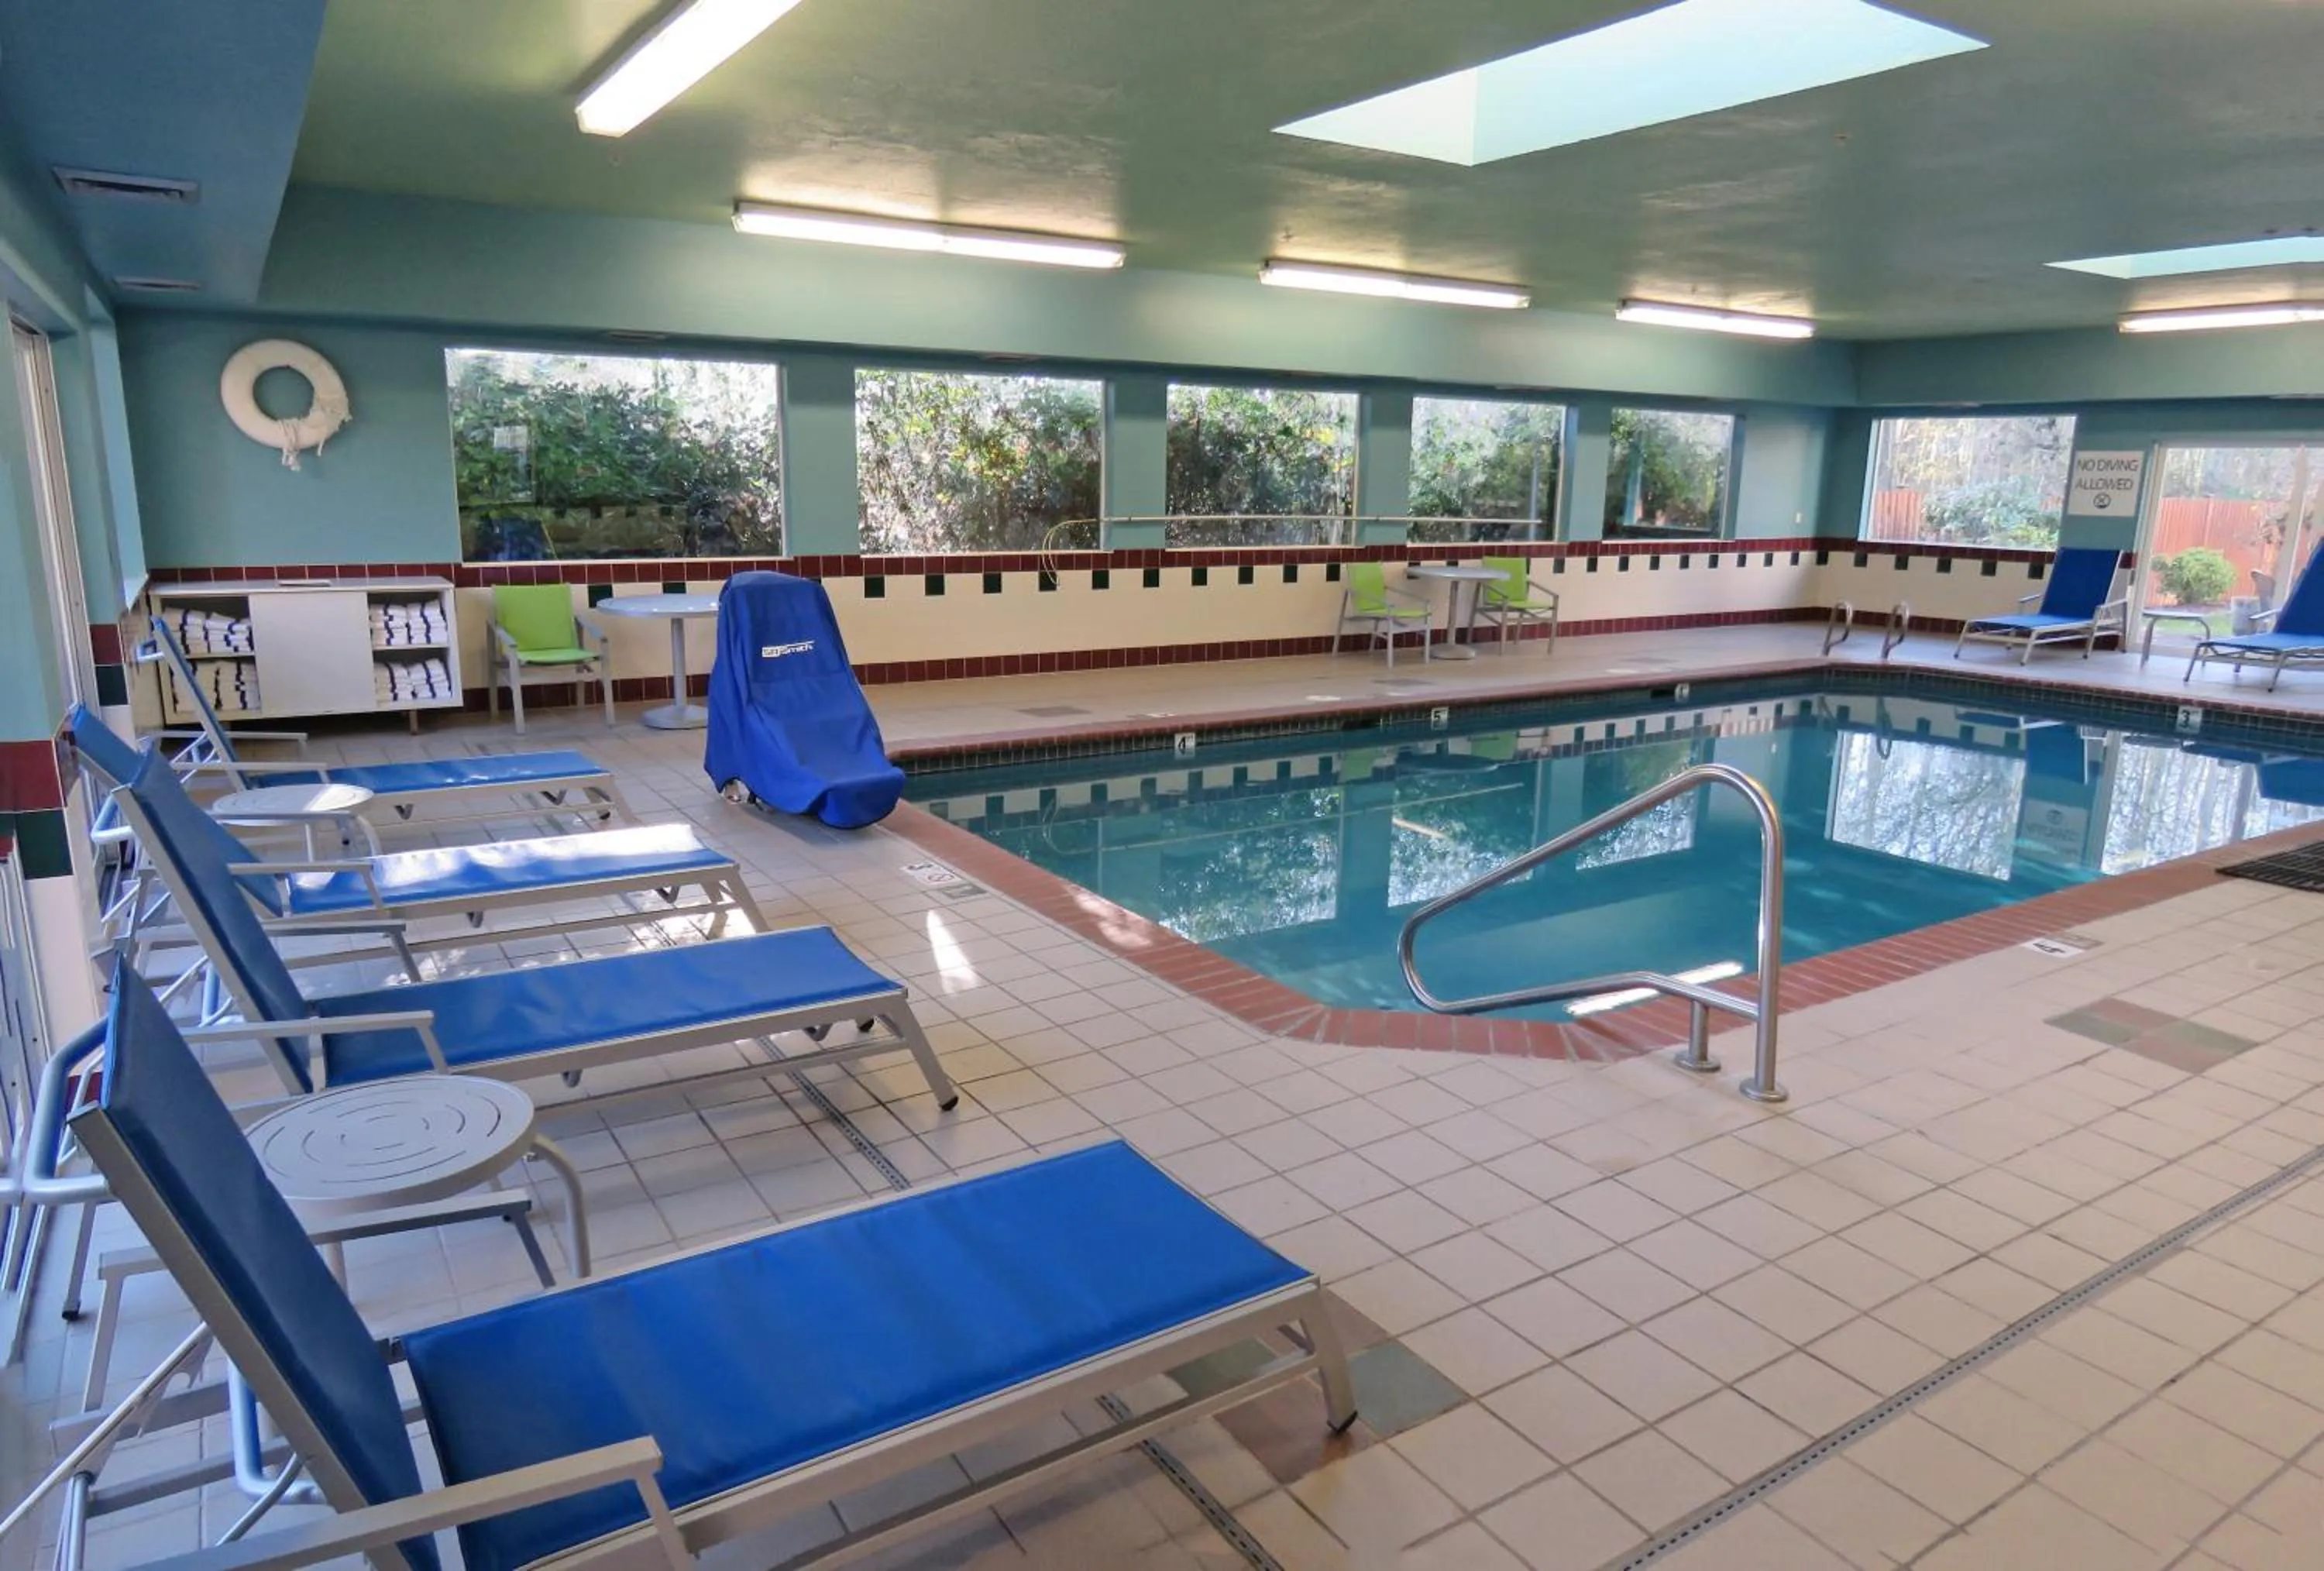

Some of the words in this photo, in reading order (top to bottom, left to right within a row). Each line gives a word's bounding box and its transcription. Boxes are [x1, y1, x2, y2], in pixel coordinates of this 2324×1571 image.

[2078, 459, 2095, 472] NO
[2096, 459, 2139, 472] DIVING
[2076, 478, 2133, 490] ALLOWED
